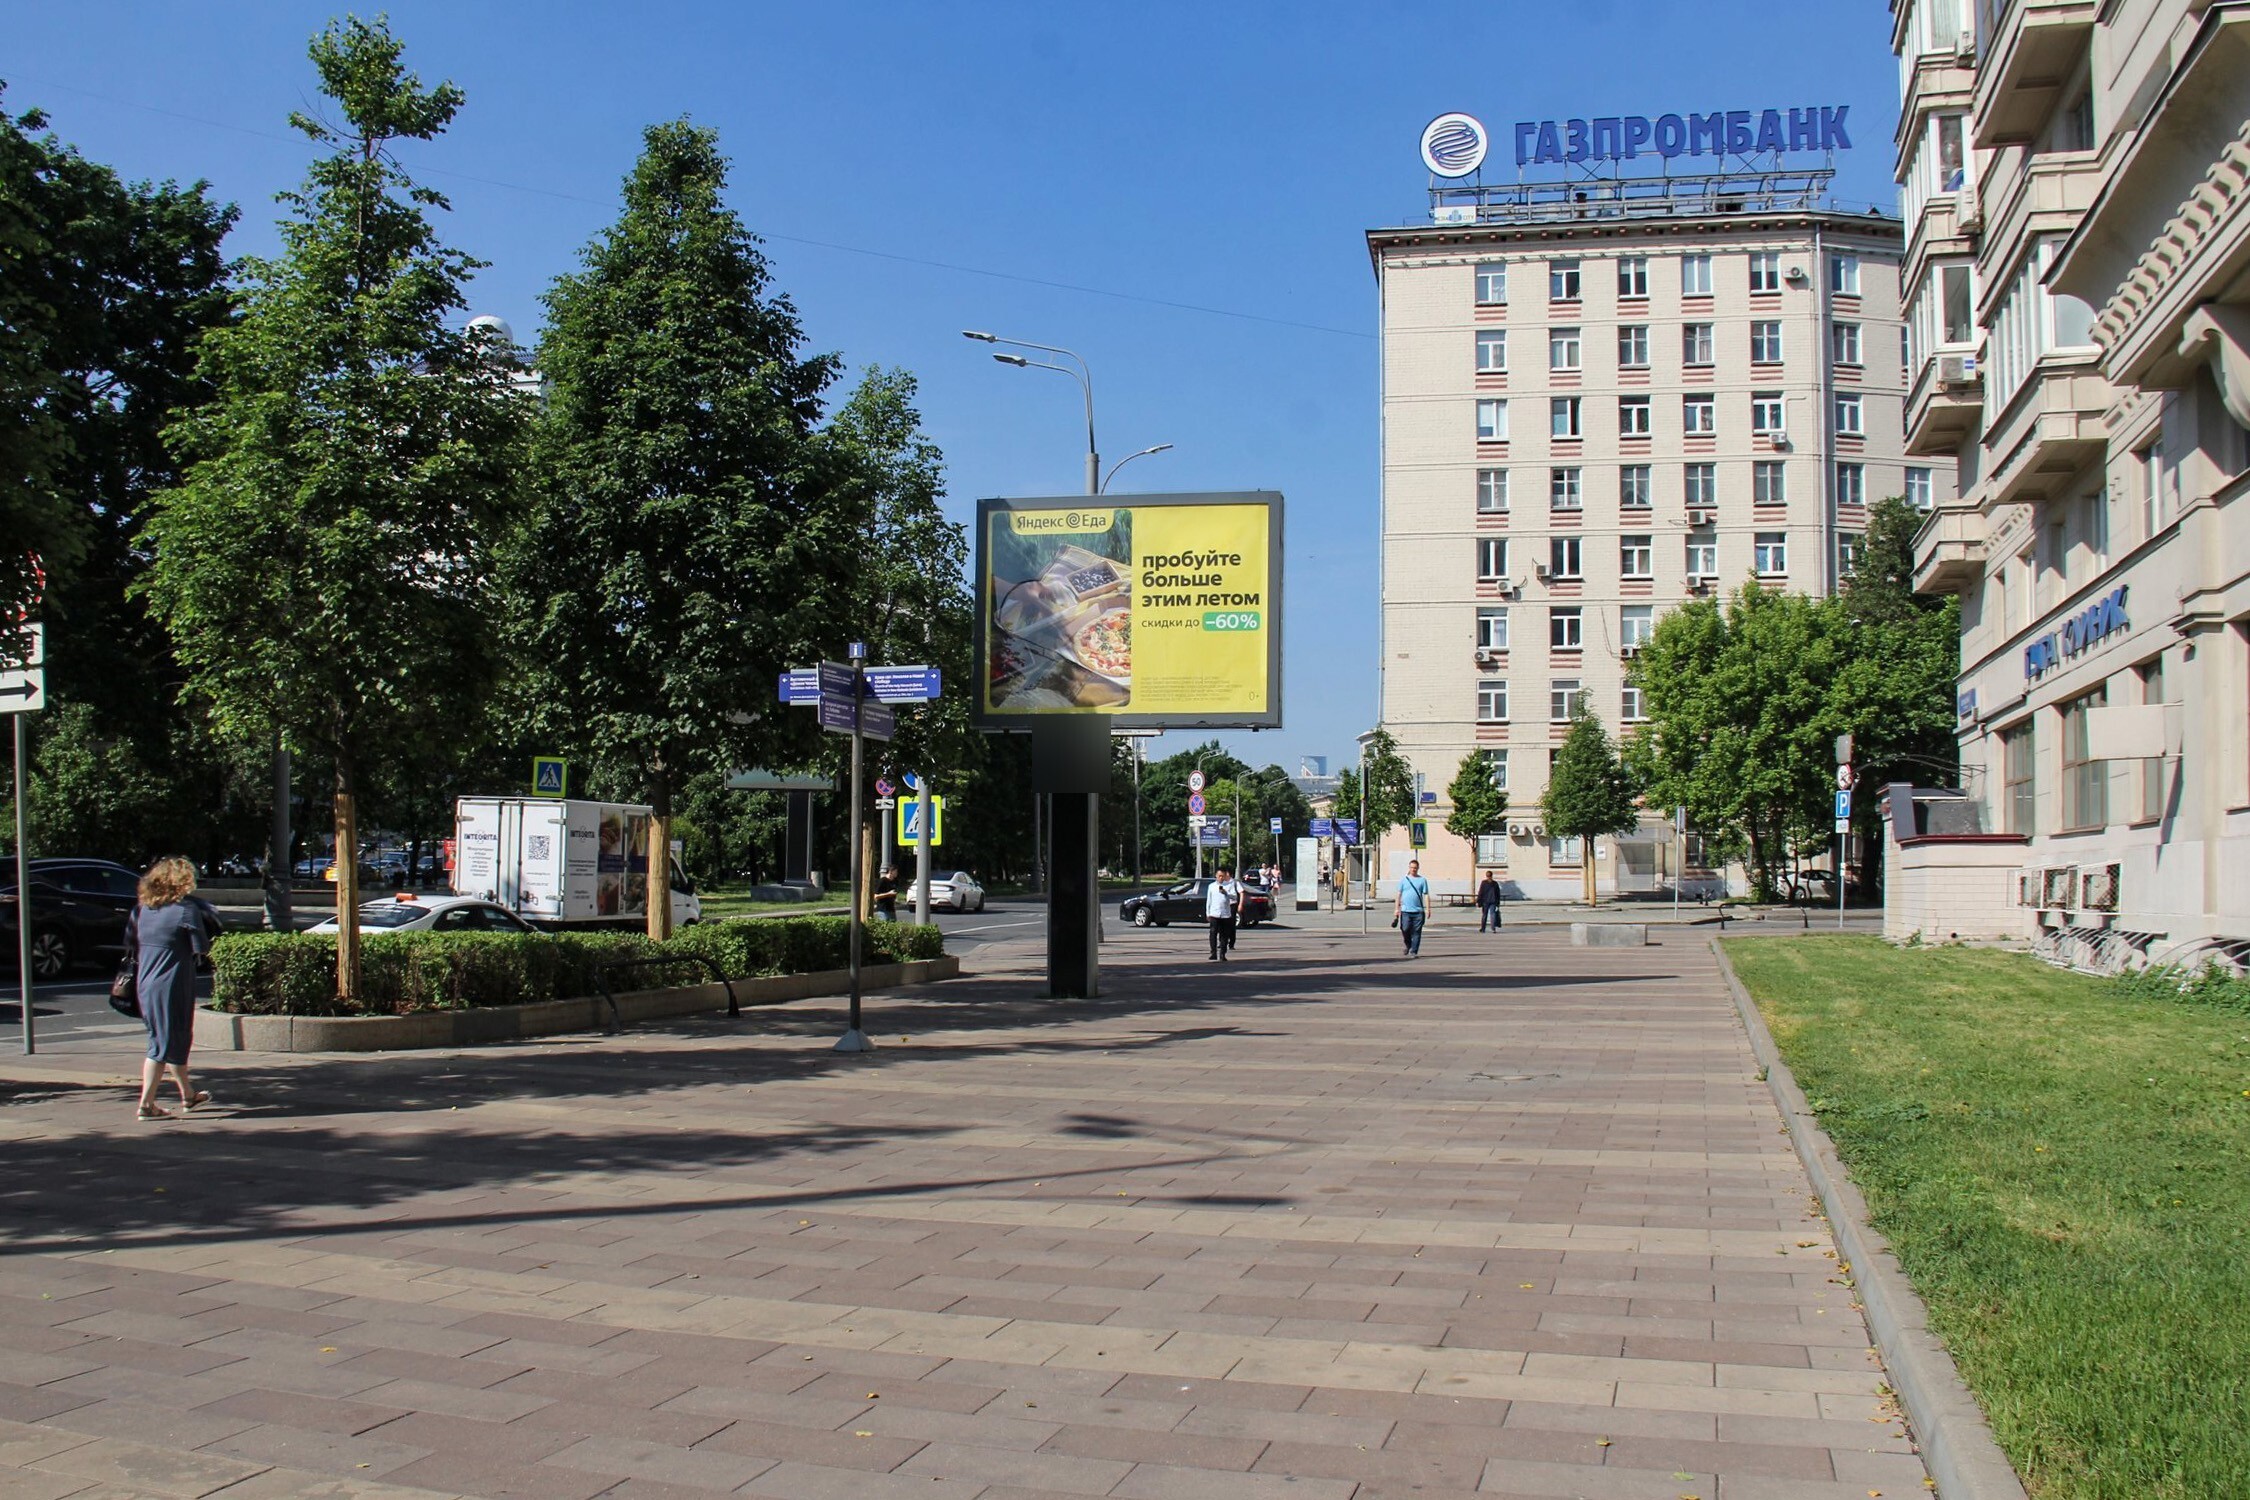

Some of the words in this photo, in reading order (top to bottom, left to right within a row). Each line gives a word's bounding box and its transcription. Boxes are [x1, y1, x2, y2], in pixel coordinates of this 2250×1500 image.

[1514, 105, 1853, 166] ГАЗПРОМБАНК
[1017, 515, 1064, 529] Яндекс
[1082, 514, 1106, 529] Еда
[1142, 550, 1241, 571] пробуйте
[1142, 570, 1222, 588] больше
[1142, 593, 1192, 608] этим
[1195, 591, 1260, 607] летом
[1142, 617, 1183, 629] скидки
[1185, 618, 1200, 629] до
[1192, 777, 1201, 787] 50
[1839, 794, 1848, 815] P
